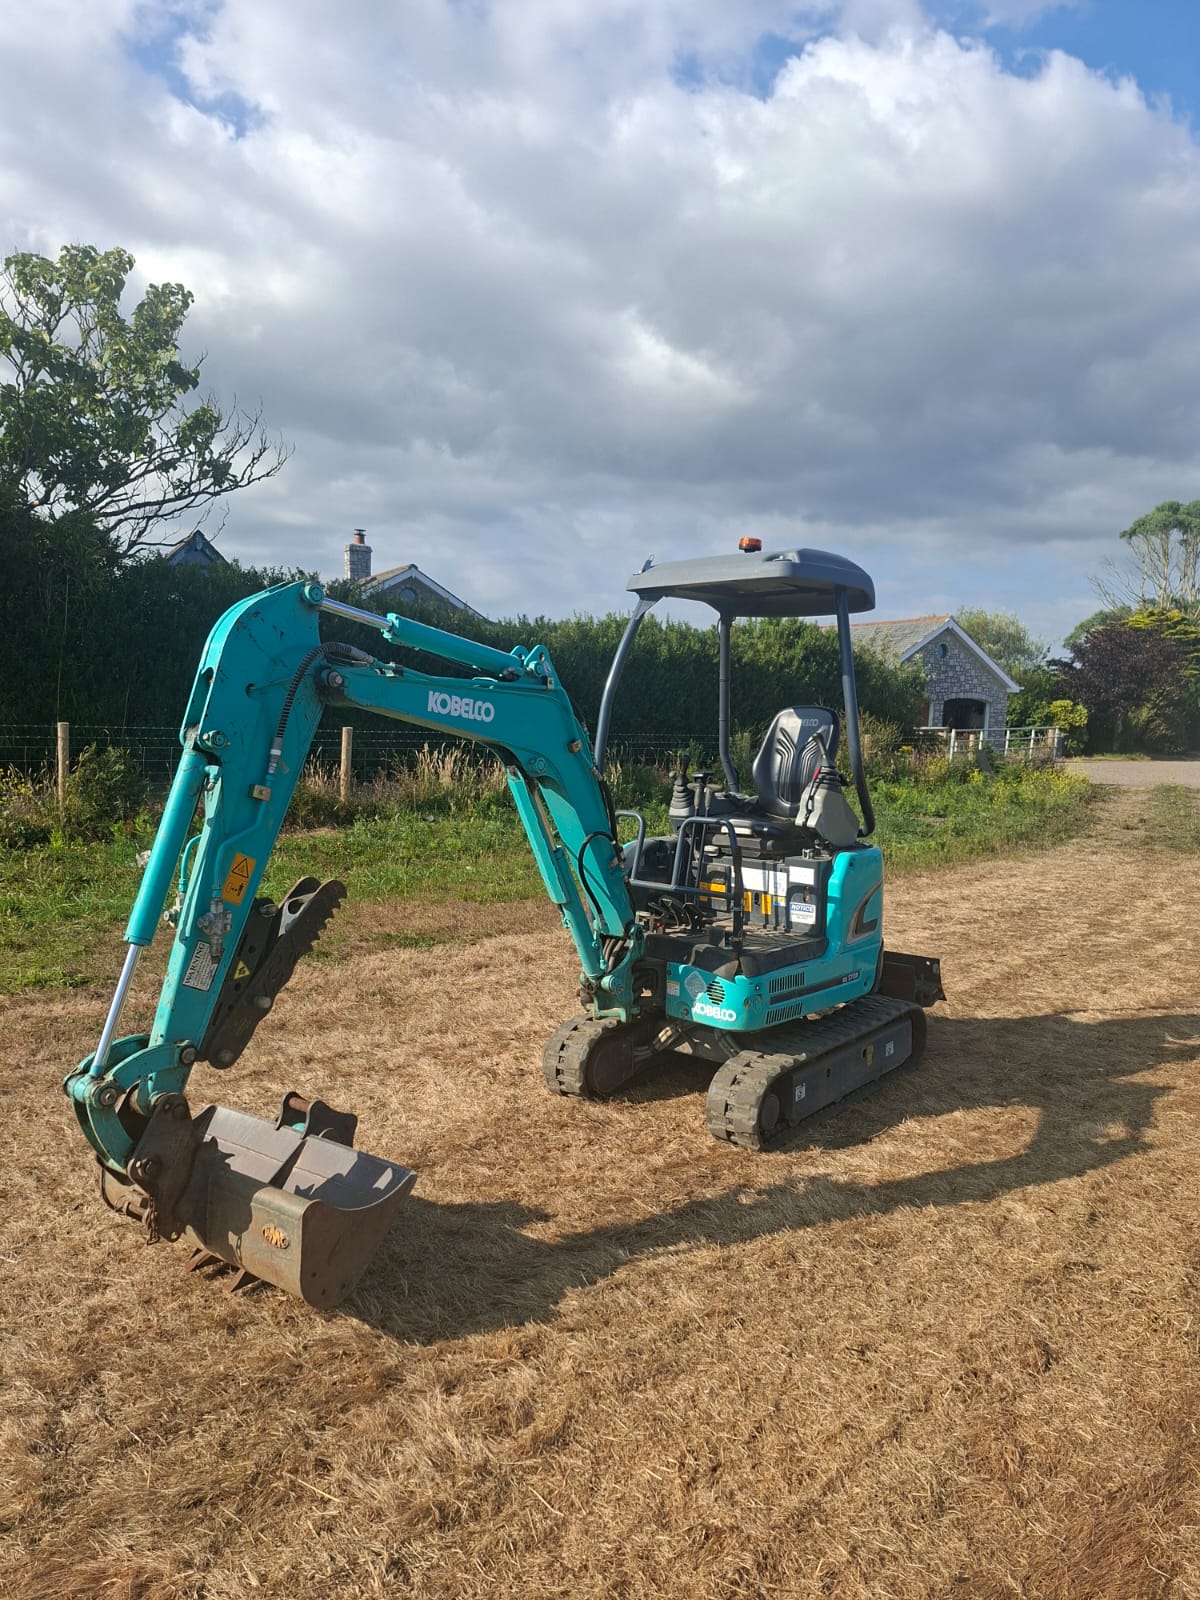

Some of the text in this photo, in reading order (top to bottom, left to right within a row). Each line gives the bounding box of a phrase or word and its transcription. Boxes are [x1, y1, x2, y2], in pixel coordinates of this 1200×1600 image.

[427, 690, 495, 723] KOBELCO
[791, 904, 815, 912] NOTICE
[185, 942, 205, 984] WARNING
